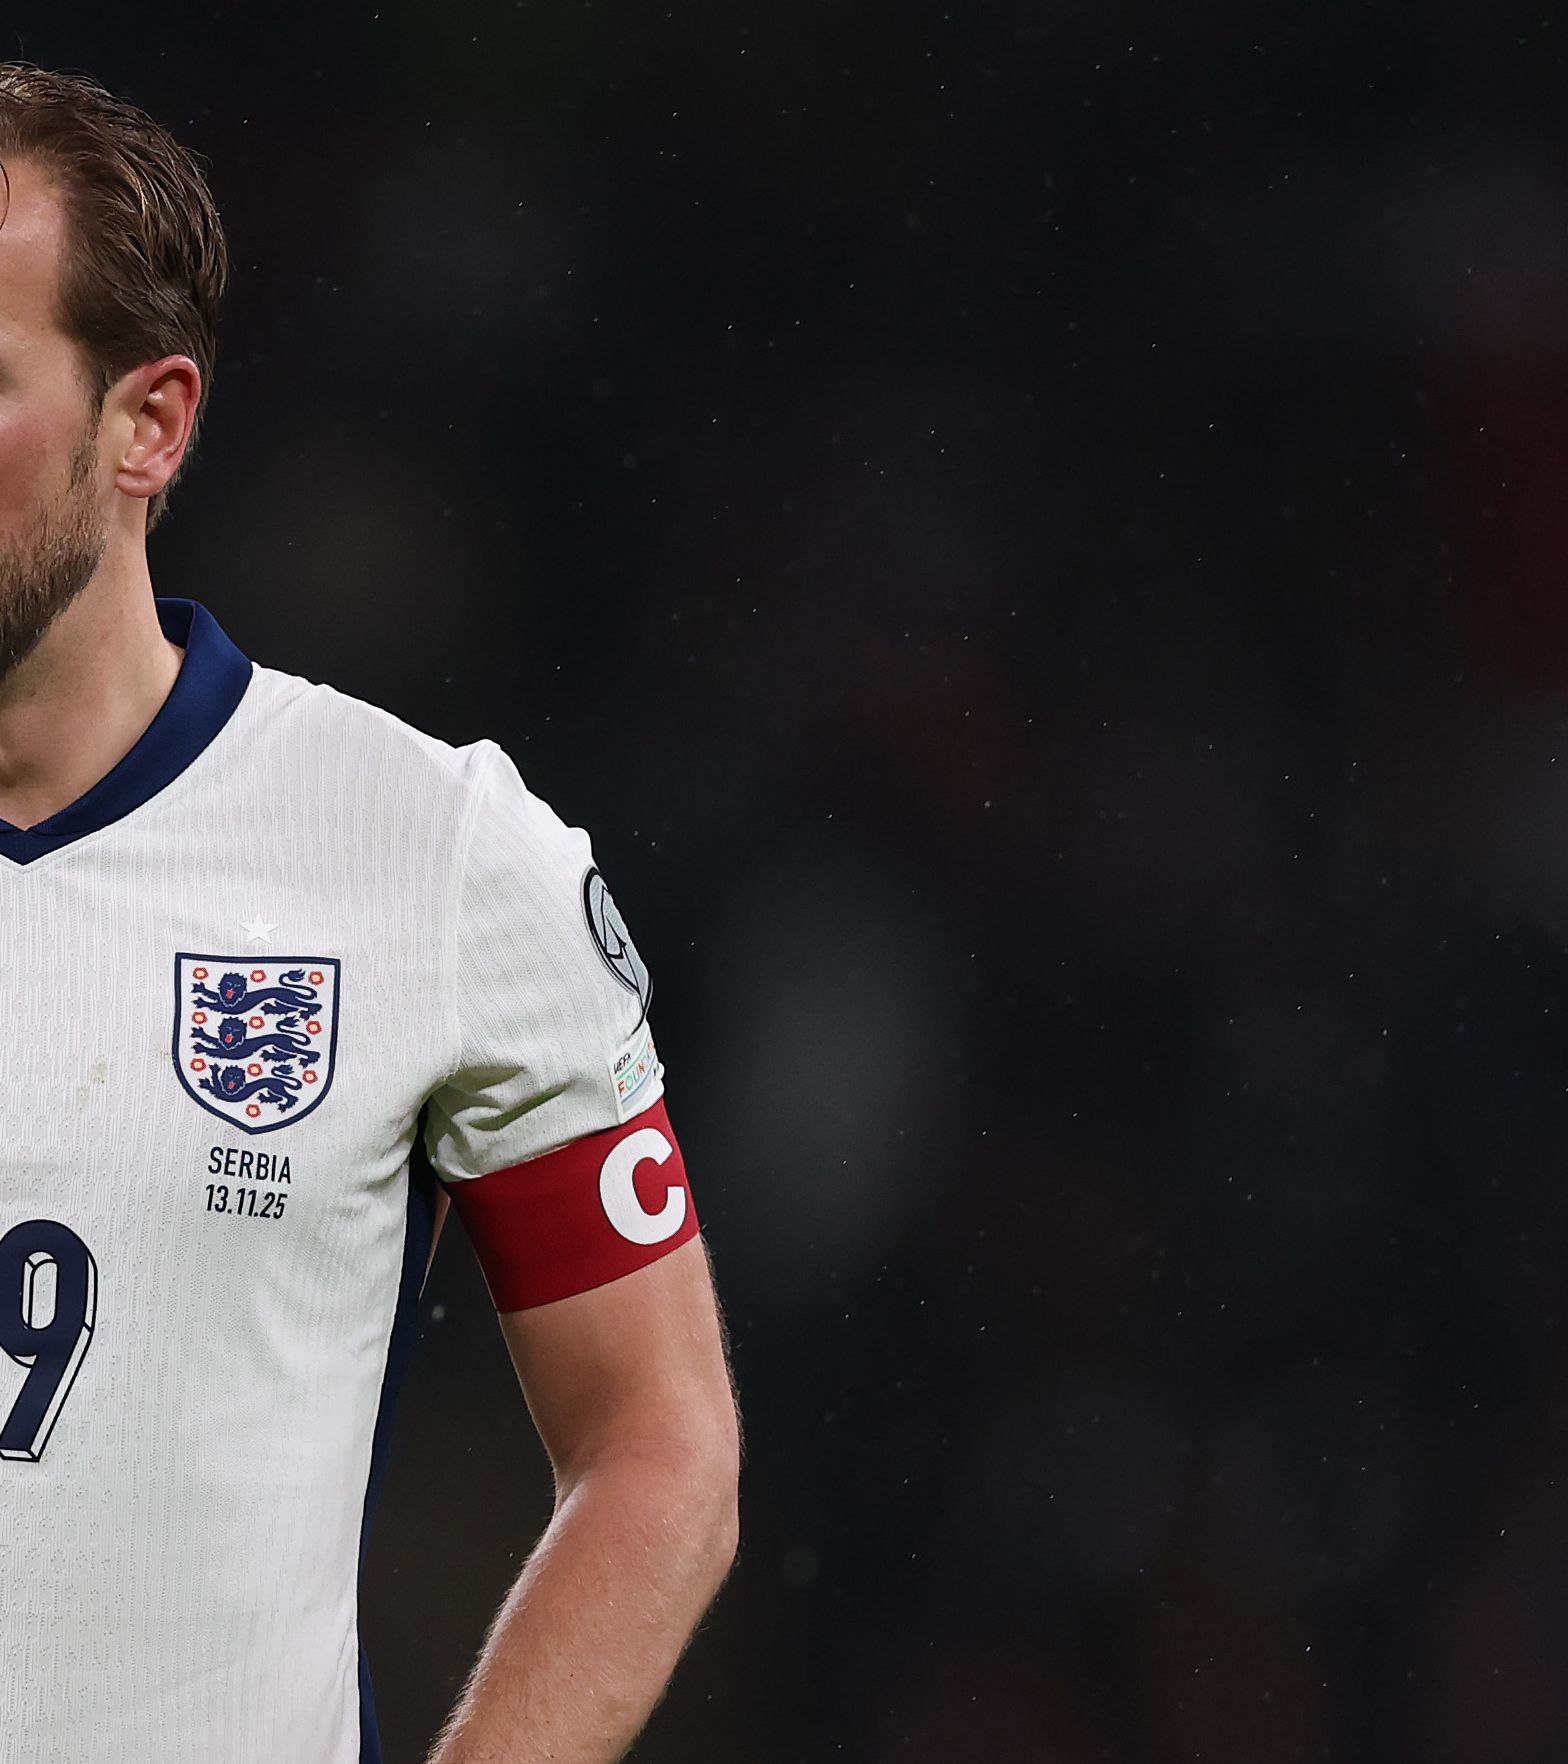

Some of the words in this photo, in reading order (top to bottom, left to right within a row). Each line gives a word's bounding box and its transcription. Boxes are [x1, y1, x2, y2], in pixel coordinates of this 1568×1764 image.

[208, 1146, 291, 1184] SERBIA
[206, 1184, 288, 1219] 13.11.25
[599, 1127, 686, 1245] C
